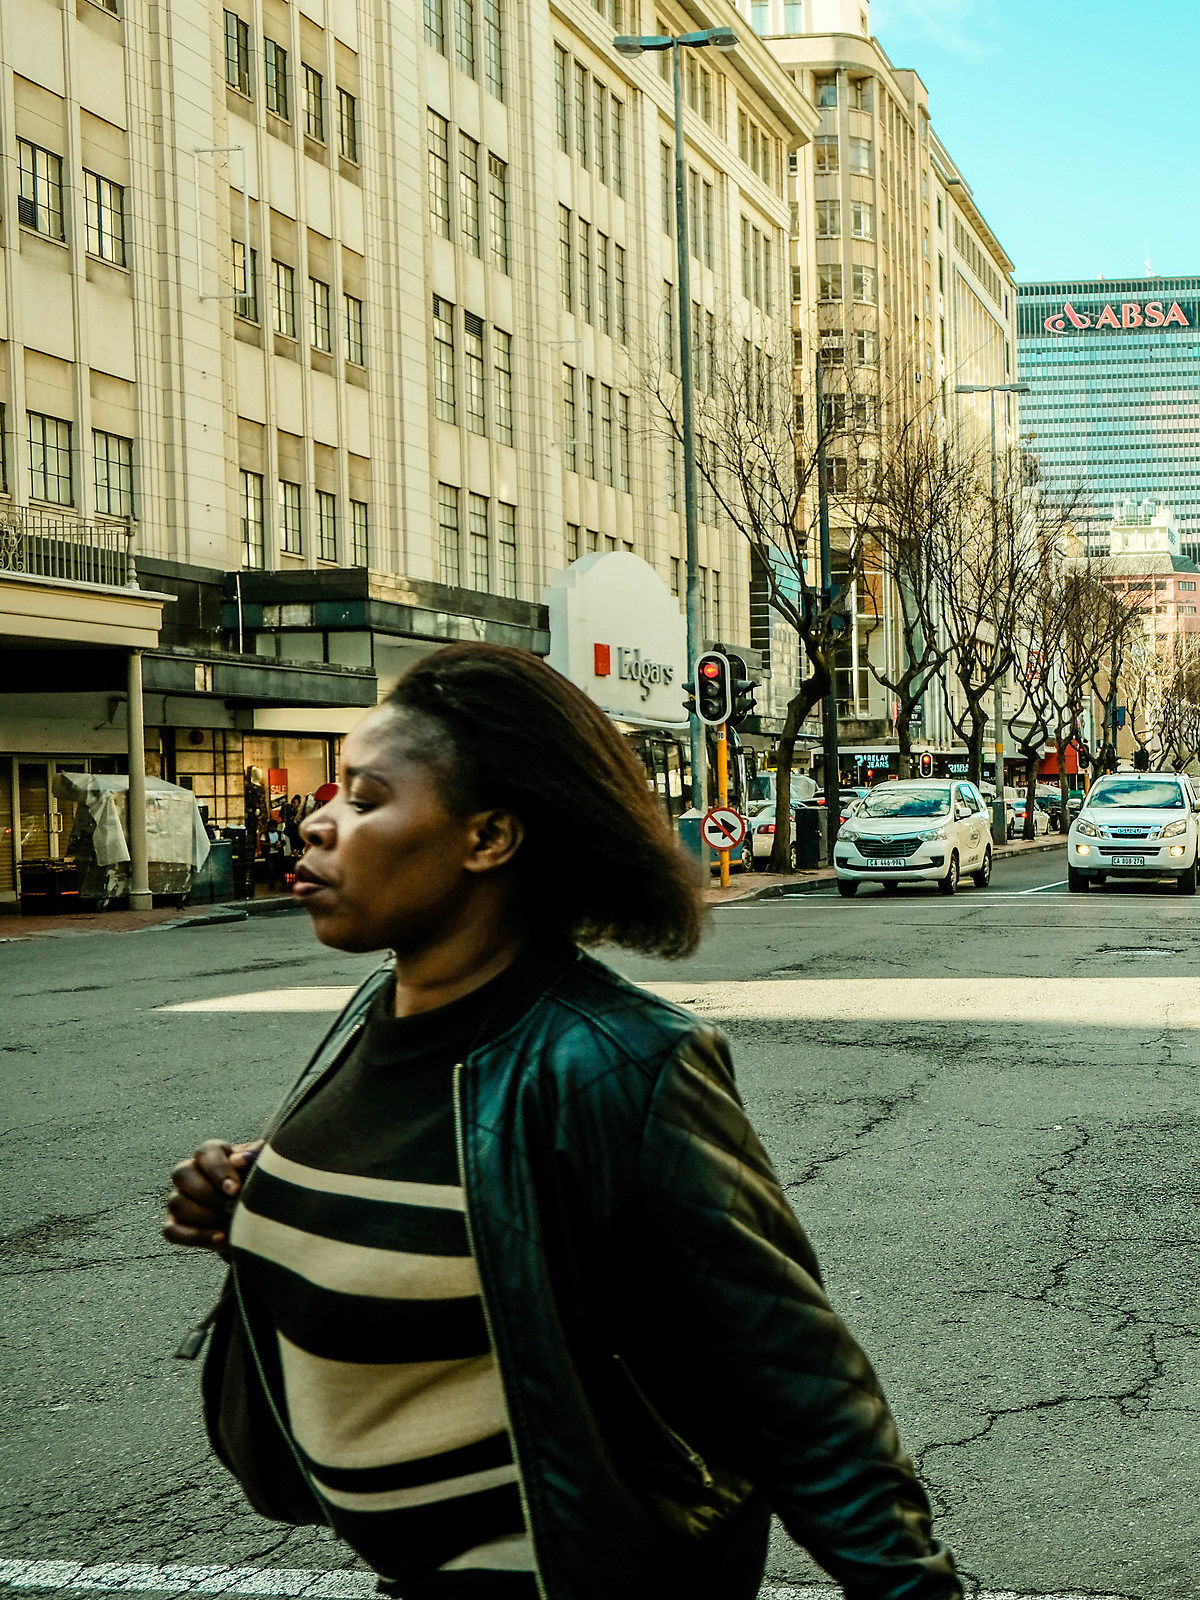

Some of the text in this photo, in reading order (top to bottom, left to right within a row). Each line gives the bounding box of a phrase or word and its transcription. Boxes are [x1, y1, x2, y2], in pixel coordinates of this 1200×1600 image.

[1096, 301, 1190, 329] ABSA
[618, 646, 674, 701] Edgars
[867, 761, 890, 769] JEANS
